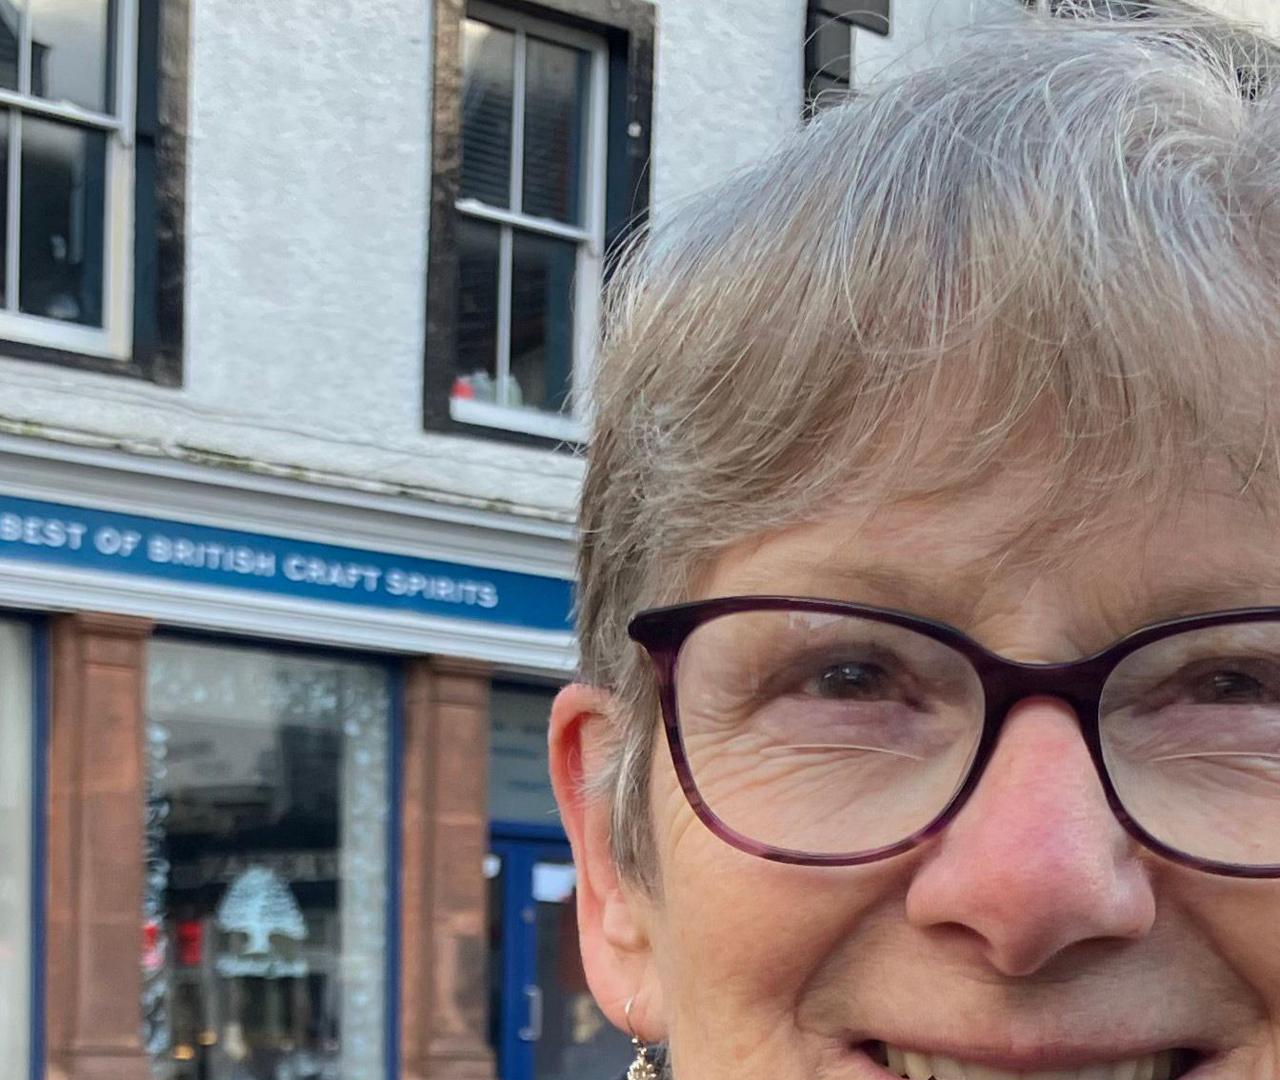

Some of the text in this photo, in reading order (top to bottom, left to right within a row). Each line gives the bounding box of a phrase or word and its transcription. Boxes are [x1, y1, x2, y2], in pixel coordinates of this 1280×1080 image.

[94, 526, 141, 557] OF
[147, 534, 276, 577] BRITISH
[282, 553, 381, 592] CRAFT
[385, 567, 499, 609] SPIRITS
